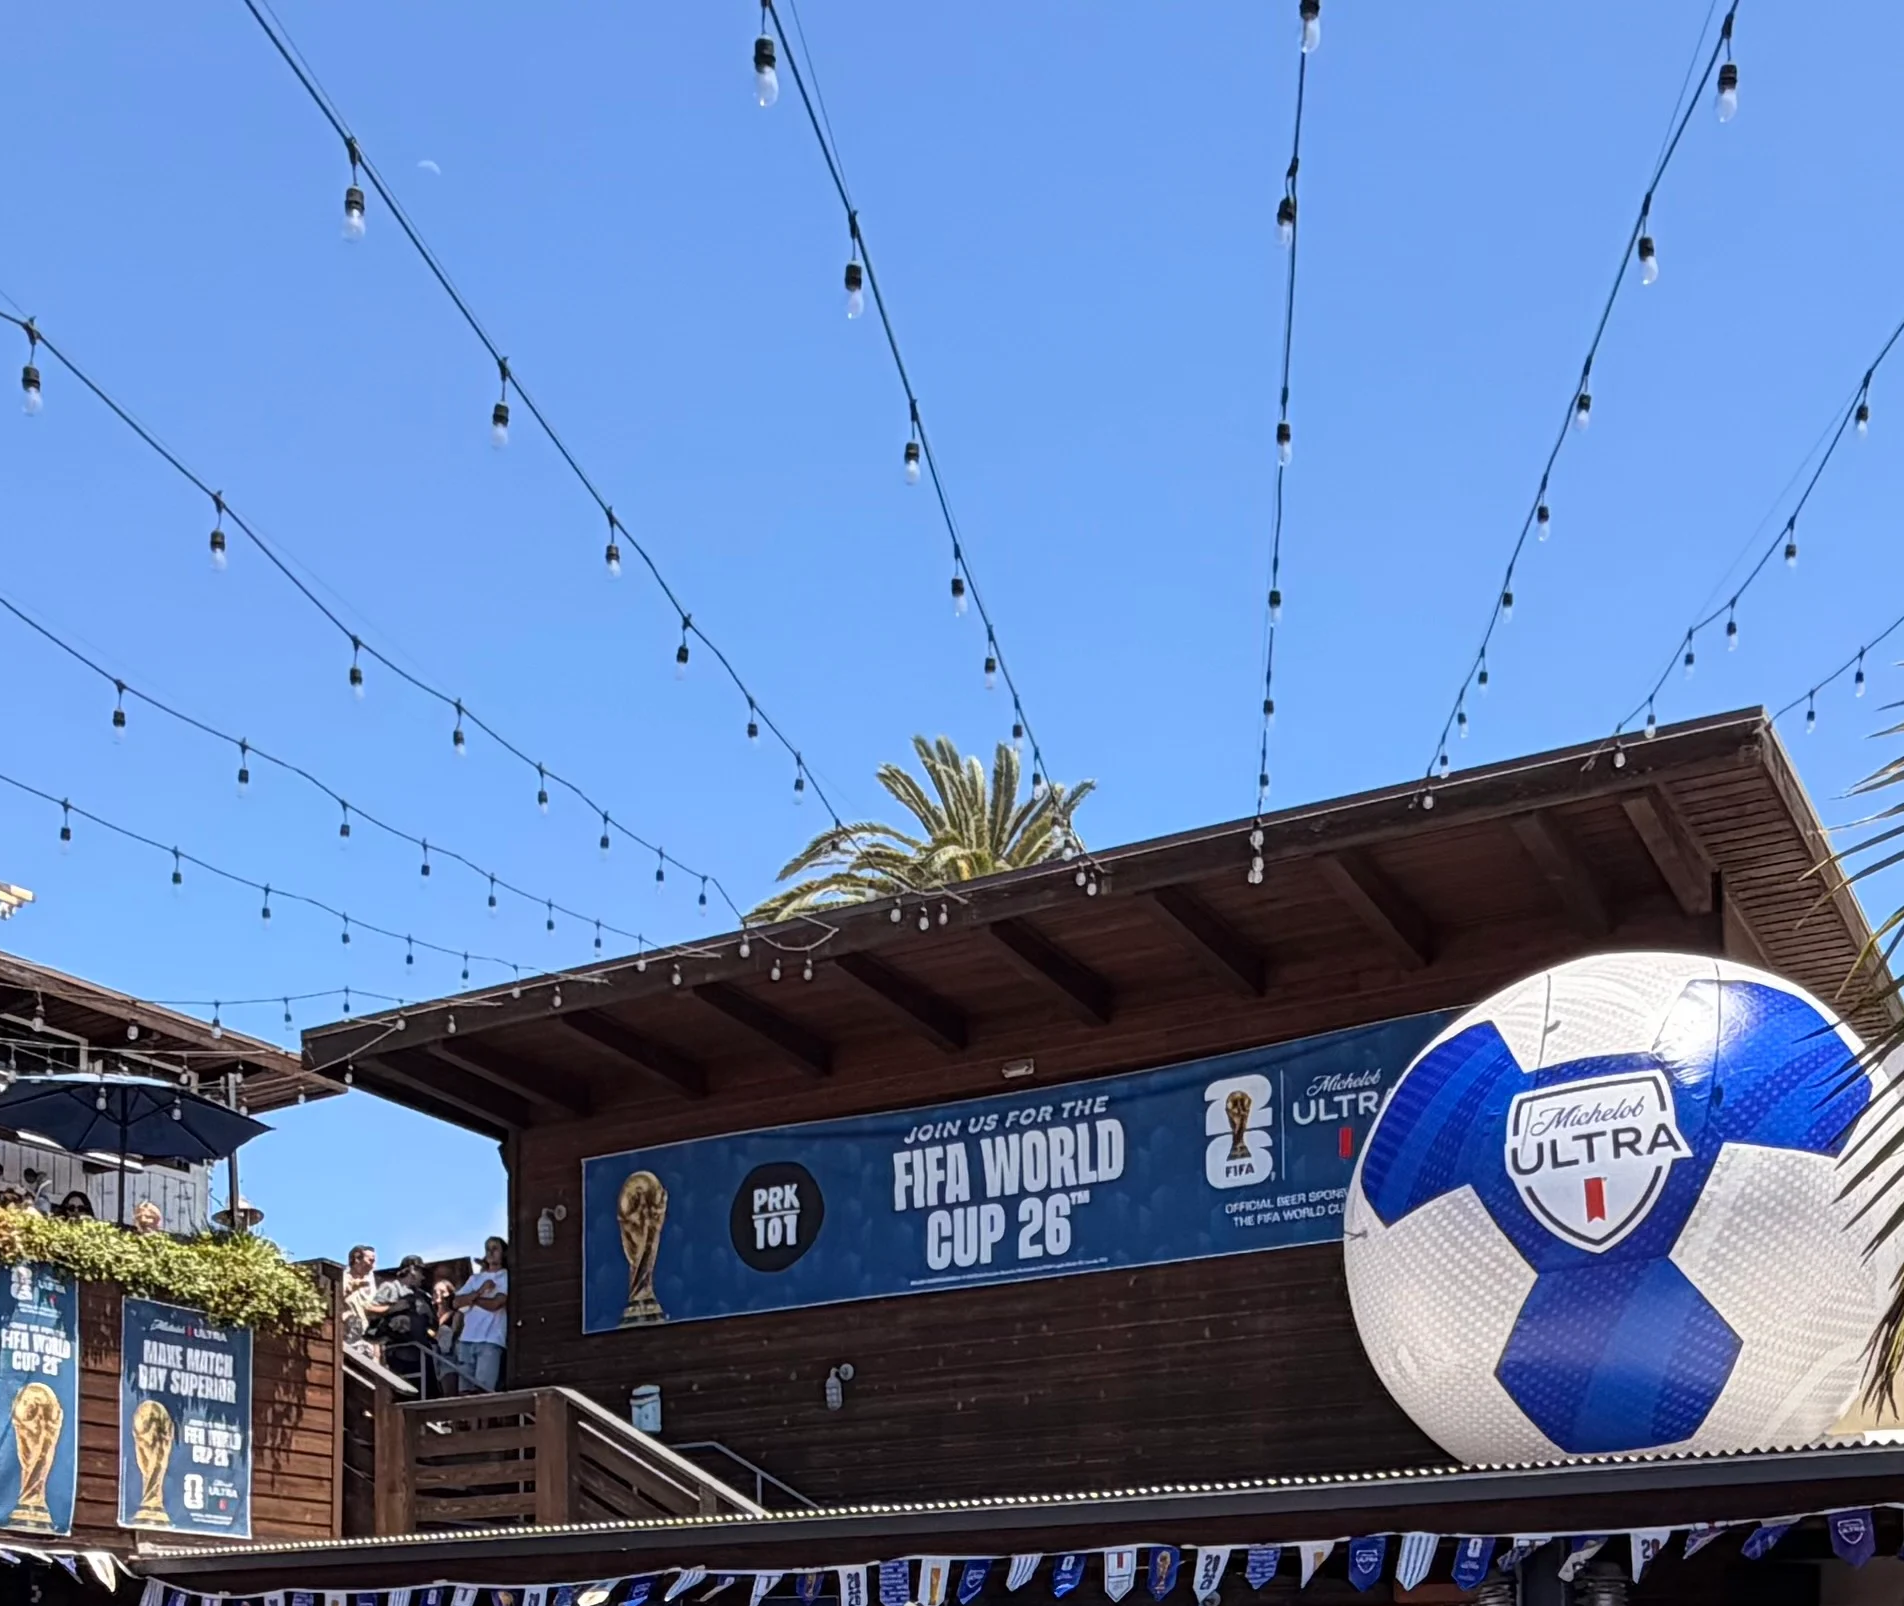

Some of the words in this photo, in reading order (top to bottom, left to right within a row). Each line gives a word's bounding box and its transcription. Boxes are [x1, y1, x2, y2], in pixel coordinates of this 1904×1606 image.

[1306, 1068, 1382, 1097] Michelob
[904, 1121, 964, 1145] JOIN
[970, 1114, 999, 1134] US
[1006, 1105, 1054, 1130] FOR
[1061, 1096, 1110, 1118] THE
[1529, 1098, 1645, 1138] Michelob
[893, 1143, 971, 1212] FIFA
[981, 1118, 1126, 1198] WORLD
[1511, 1122, 1684, 1177] ULTRA
[1224, 1160, 1256, 1179] FIFA
[753, 1184, 800, 1213] PRK
[1225, 1196, 1273, 1216] OFFICIAL
[1276, 1193, 1306, 1208] BEER
[1233, 1213, 1254, 1228] THE
[1256, 1210, 1280, 1225] FIFA
[1282, 1205, 1325, 1222] WORLD
[755, 1217, 798, 1251] 101
[926, 1204, 1006, 1272] CUP
[12, 1351, 39, 1373] CUP
[143, 1340, 183, 1368] MAKE
[186, 1348, 234, 1379] MATCH
[138, 1363, 167, 1391] DAY
[170, 1372, 236, 1405] SUPERIOR
